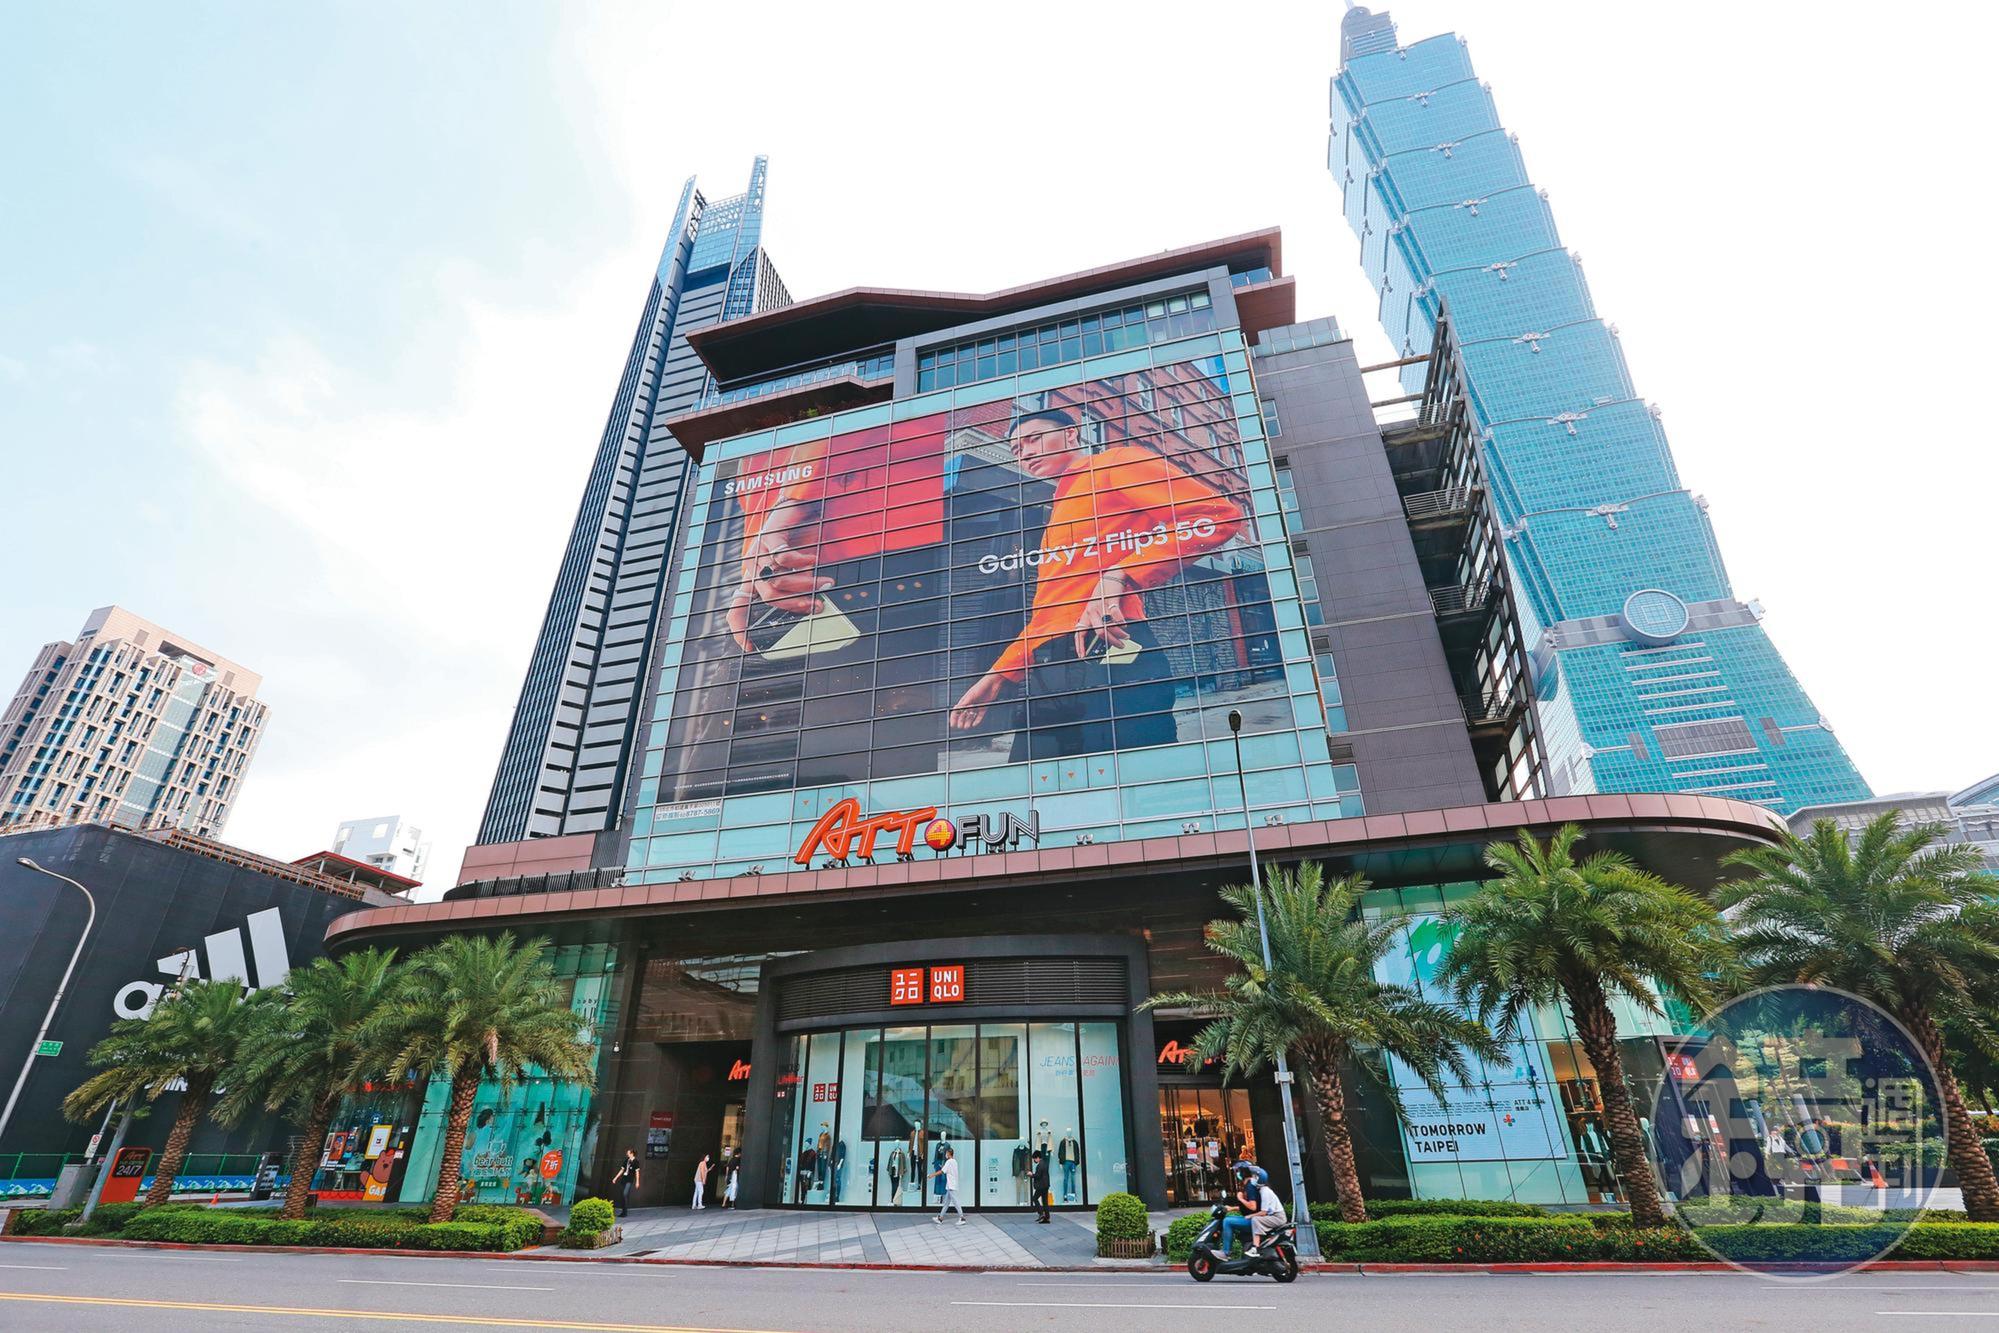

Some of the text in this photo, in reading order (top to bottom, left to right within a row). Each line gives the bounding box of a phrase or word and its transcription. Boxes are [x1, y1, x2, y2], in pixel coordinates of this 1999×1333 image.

[724, 465, 813, 494] SAMSUNG
[978, 517, 1216, 574] Galaxy Z Flip3 5G
[934, 970, 958, 983] UNI
[933, 984, 960, 1000] QLO
[1039, 1056, 1075, 1068] JEANS
[1413, 1123, 1486, 1137] TOMORROW
[1415, 1140, 1460, 1153] TAIPEI
[116, 1165, 143, 1176] 24/7
